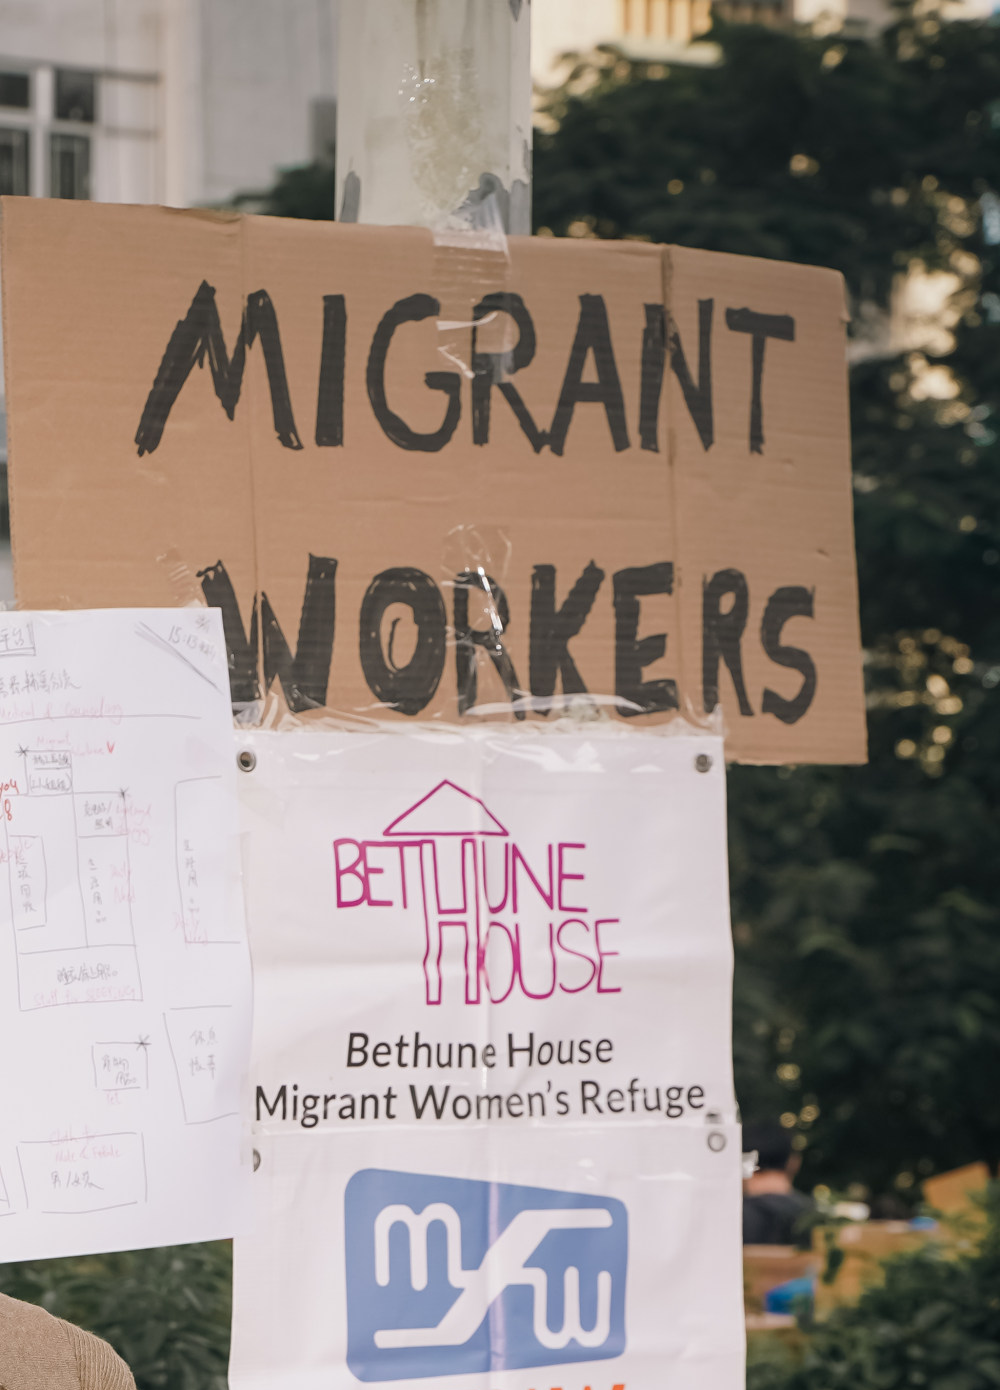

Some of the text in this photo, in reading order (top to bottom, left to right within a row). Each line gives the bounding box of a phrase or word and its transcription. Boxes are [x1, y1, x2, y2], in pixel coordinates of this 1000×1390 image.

[137, 280, 795, 457] MIGRANT
[198, 552, 818, 725] WORKERS
[0, 779, 19, 802] you
[333, 838, 588, 914] BETHUNE
[423, 919, 621, 1005] HOUSE
[345, 1031, 614, 1068] Bethune House
[255, 1078, 706, 1127] Migrant Women's Refuge
